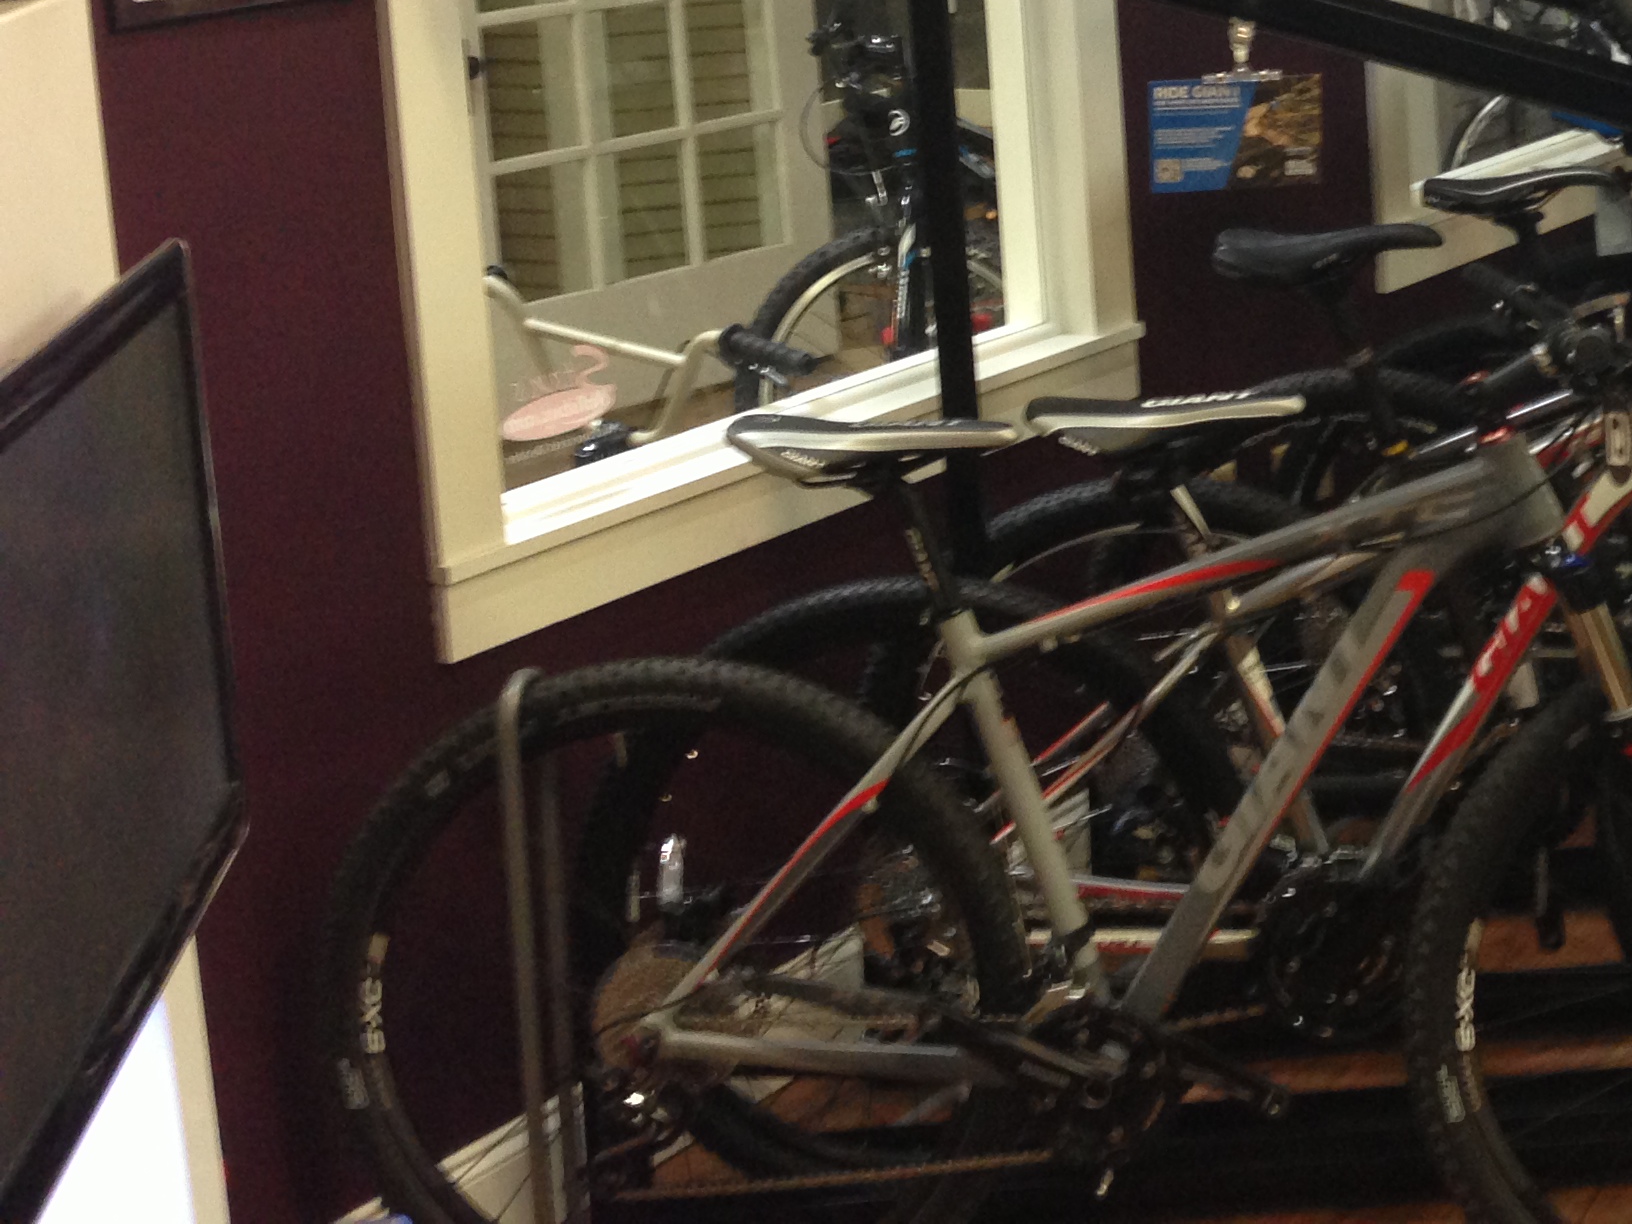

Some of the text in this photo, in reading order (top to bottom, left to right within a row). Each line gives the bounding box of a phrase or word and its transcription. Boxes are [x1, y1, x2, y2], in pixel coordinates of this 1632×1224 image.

[1152, 84, 1242, 101] RIDE GIANT
[1140, 389, 1252, 409] GIANT
